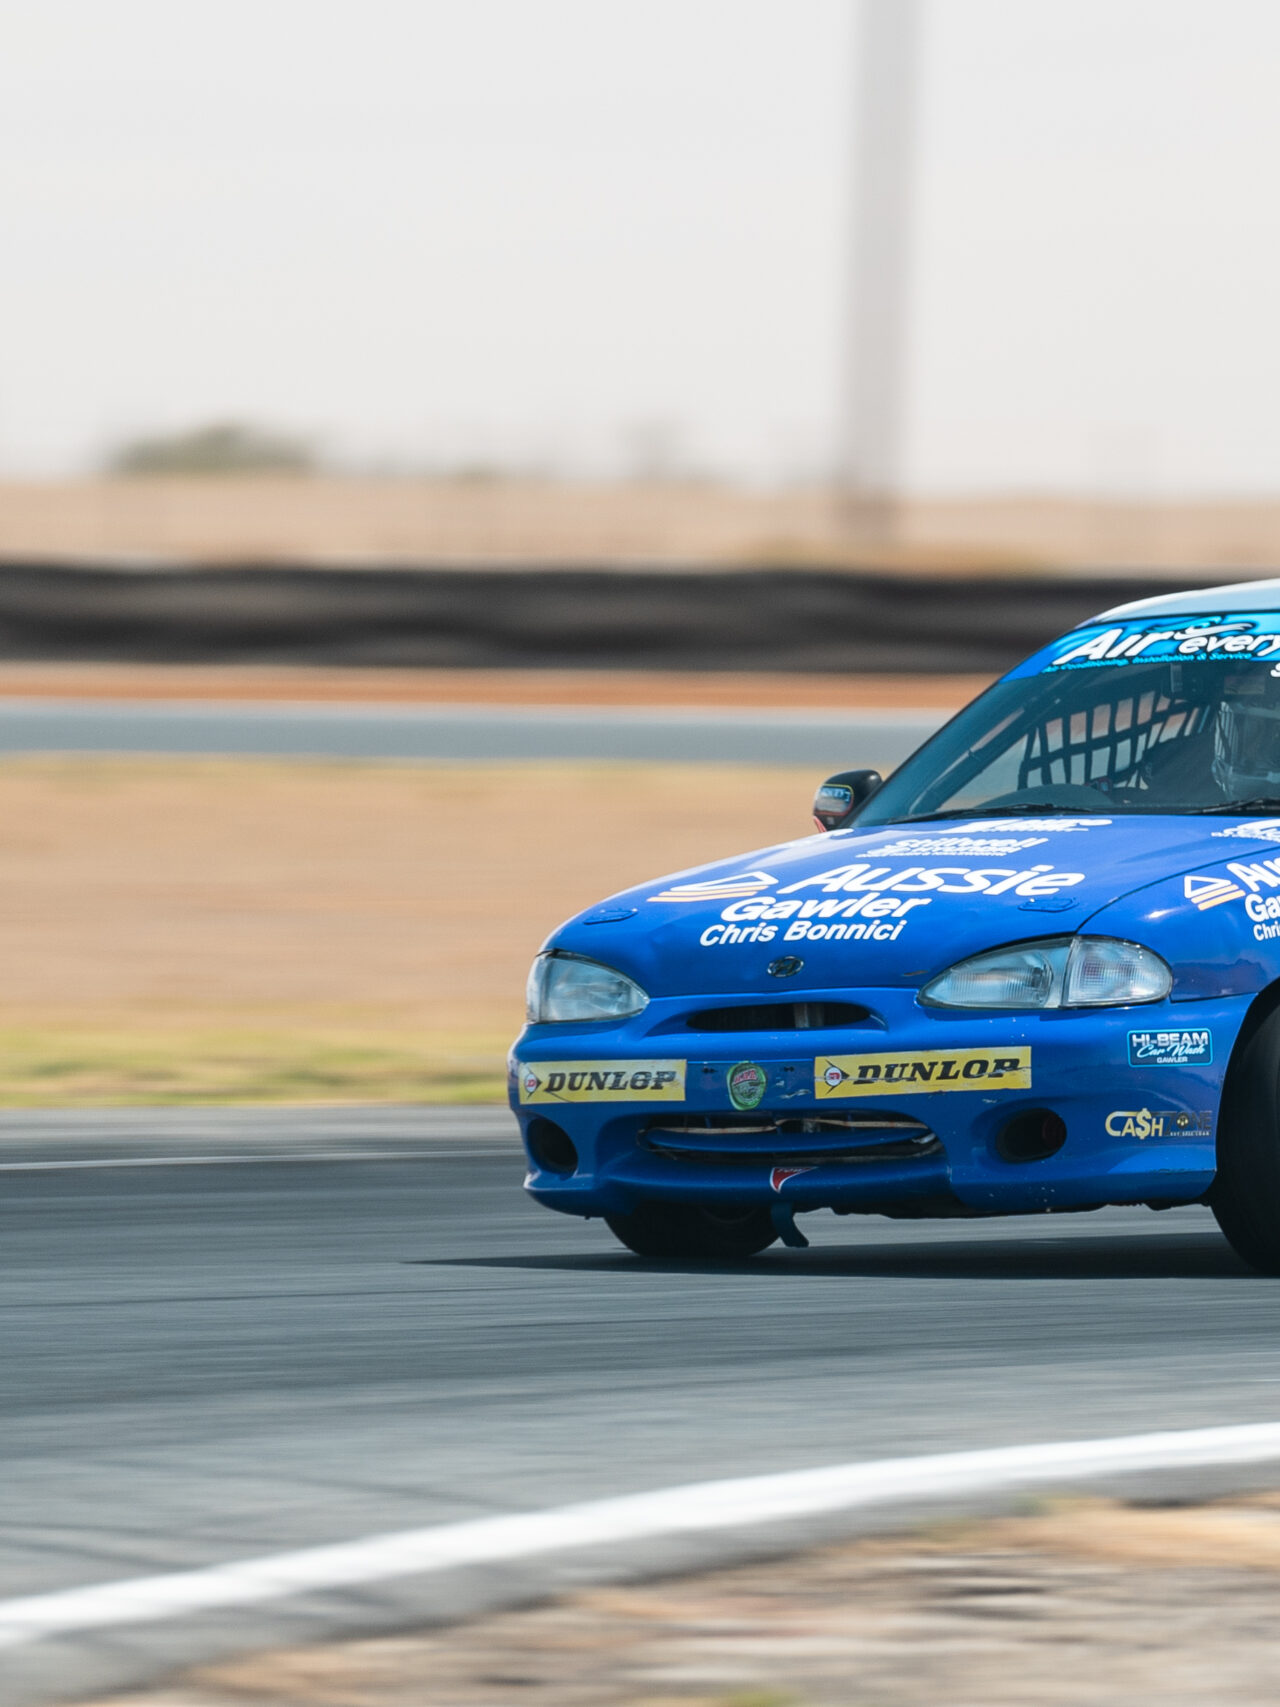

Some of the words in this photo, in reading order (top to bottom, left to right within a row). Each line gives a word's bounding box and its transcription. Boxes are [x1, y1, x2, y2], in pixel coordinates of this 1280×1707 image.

[1052, 628, 1176, 665] Air
[776, 864, 1085, 896] Aussie
[720, 892, 932, 922] Gawler
[700, 922, 778, 947] Chris
[783, 919, 908, 942] Bonnici
[1132, 1031, 1209, 1047] HI-BEAM
[1136, 1043, 1165, 1058] Car
[1166, 1042, 1206, 1057] Wash
[852, 1058, 1020, 1085] DUNLOP
[1156, 1056, 1189, 1064] GAWLER
[543, 1071, 677, 1092] DUNLOP
